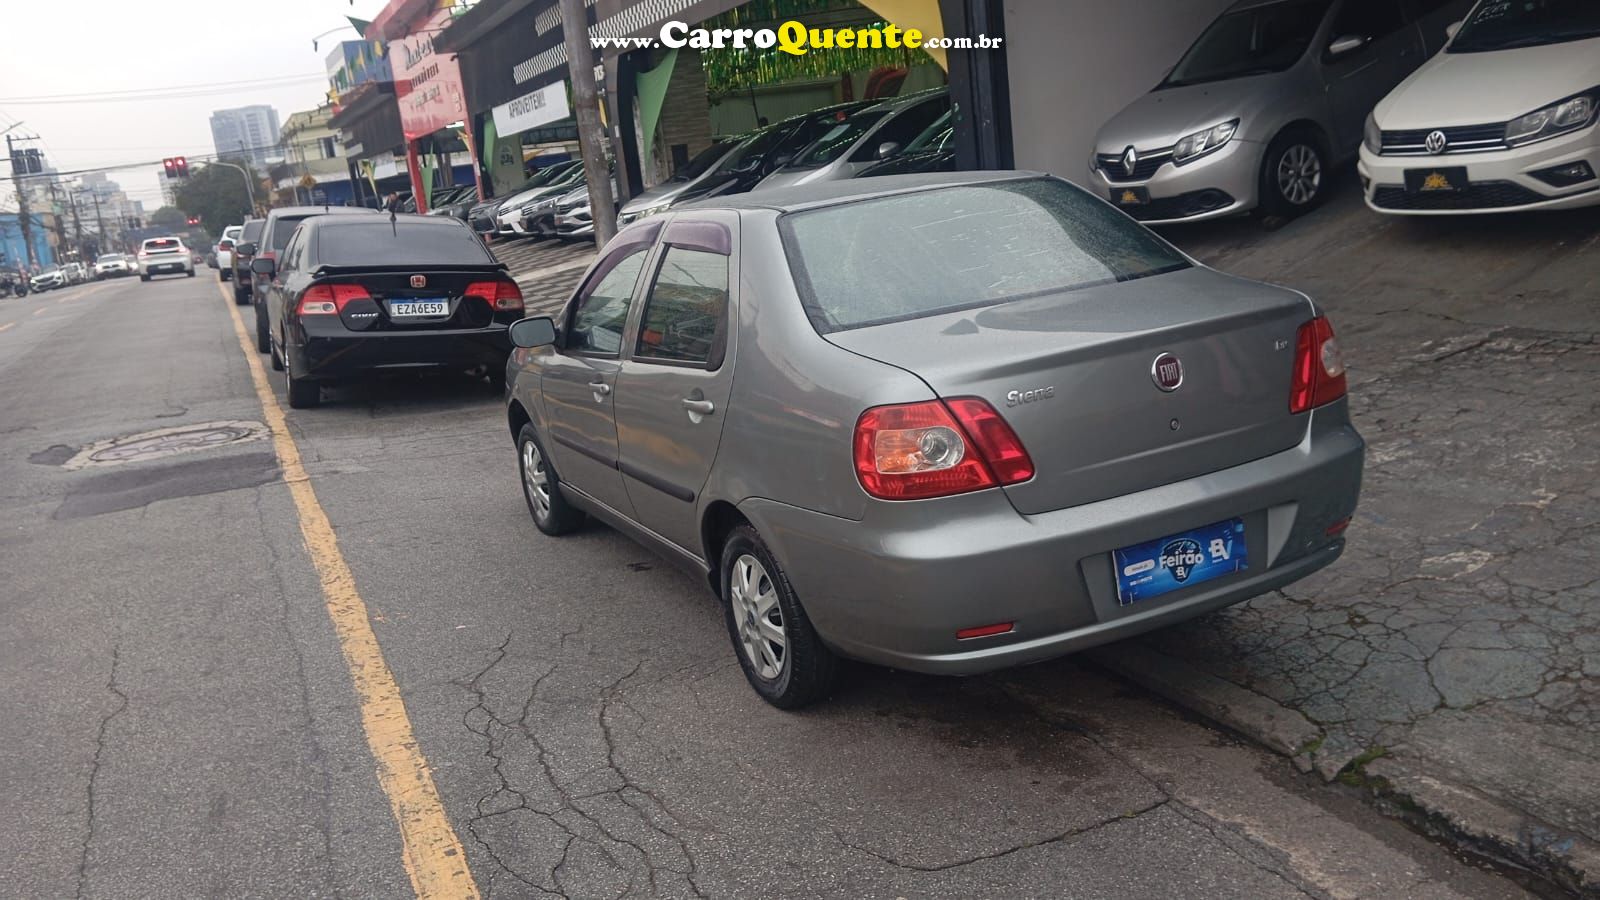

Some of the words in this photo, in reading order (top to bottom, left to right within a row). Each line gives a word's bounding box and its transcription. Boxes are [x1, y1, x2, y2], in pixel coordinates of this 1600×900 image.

[397, 303, 444, 315] EZA6E59
[1159, 361, 1179, 382] FIAT
[1006, 386, 1055, 408] Siena
[1158, 549, 1205, 570] Feirão
